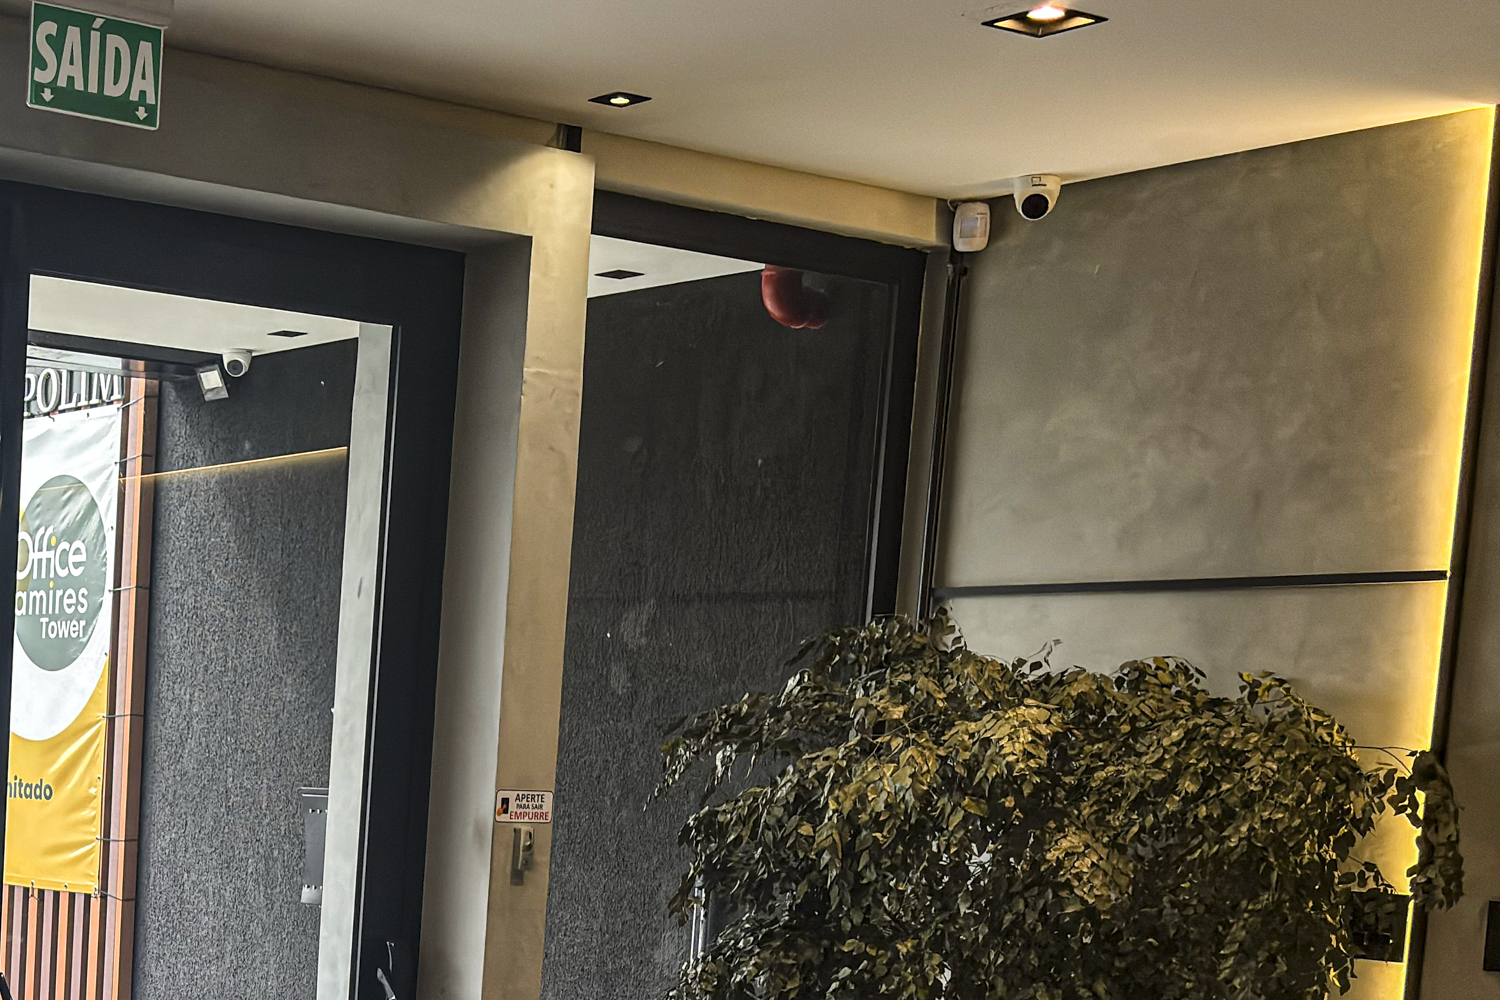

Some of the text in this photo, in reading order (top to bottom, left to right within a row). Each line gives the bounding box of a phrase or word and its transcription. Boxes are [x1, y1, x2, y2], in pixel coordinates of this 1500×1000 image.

[34, 18, 156, 105] SAÍDA
[40, 616, 86, 639] Tower
[515, 793, 546, 803] APERTE
[509, 810, 549, 821] EMPURRE
